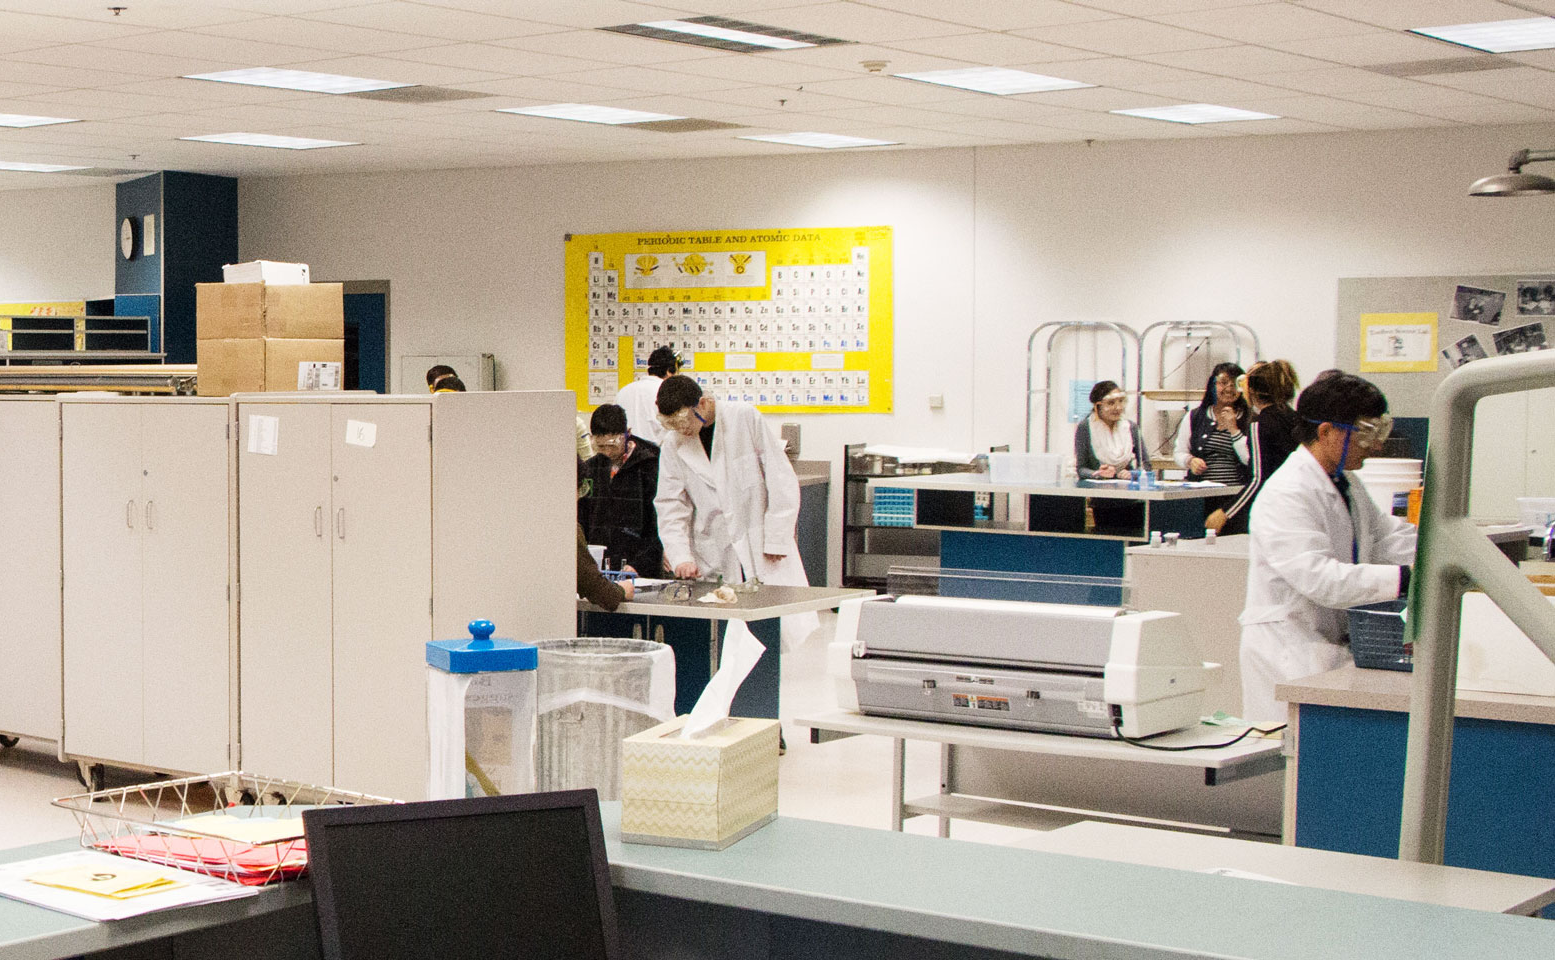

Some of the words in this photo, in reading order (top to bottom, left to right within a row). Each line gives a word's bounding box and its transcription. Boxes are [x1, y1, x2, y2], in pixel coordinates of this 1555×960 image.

[637, 236, 686, 246] PERIODIC
[688, 236, 722, 244] TABLE
[725, 235, 746, 244] AND
[750, 234, 790, 242] ATOMIC
[793, 233, 821, 242] DATA
